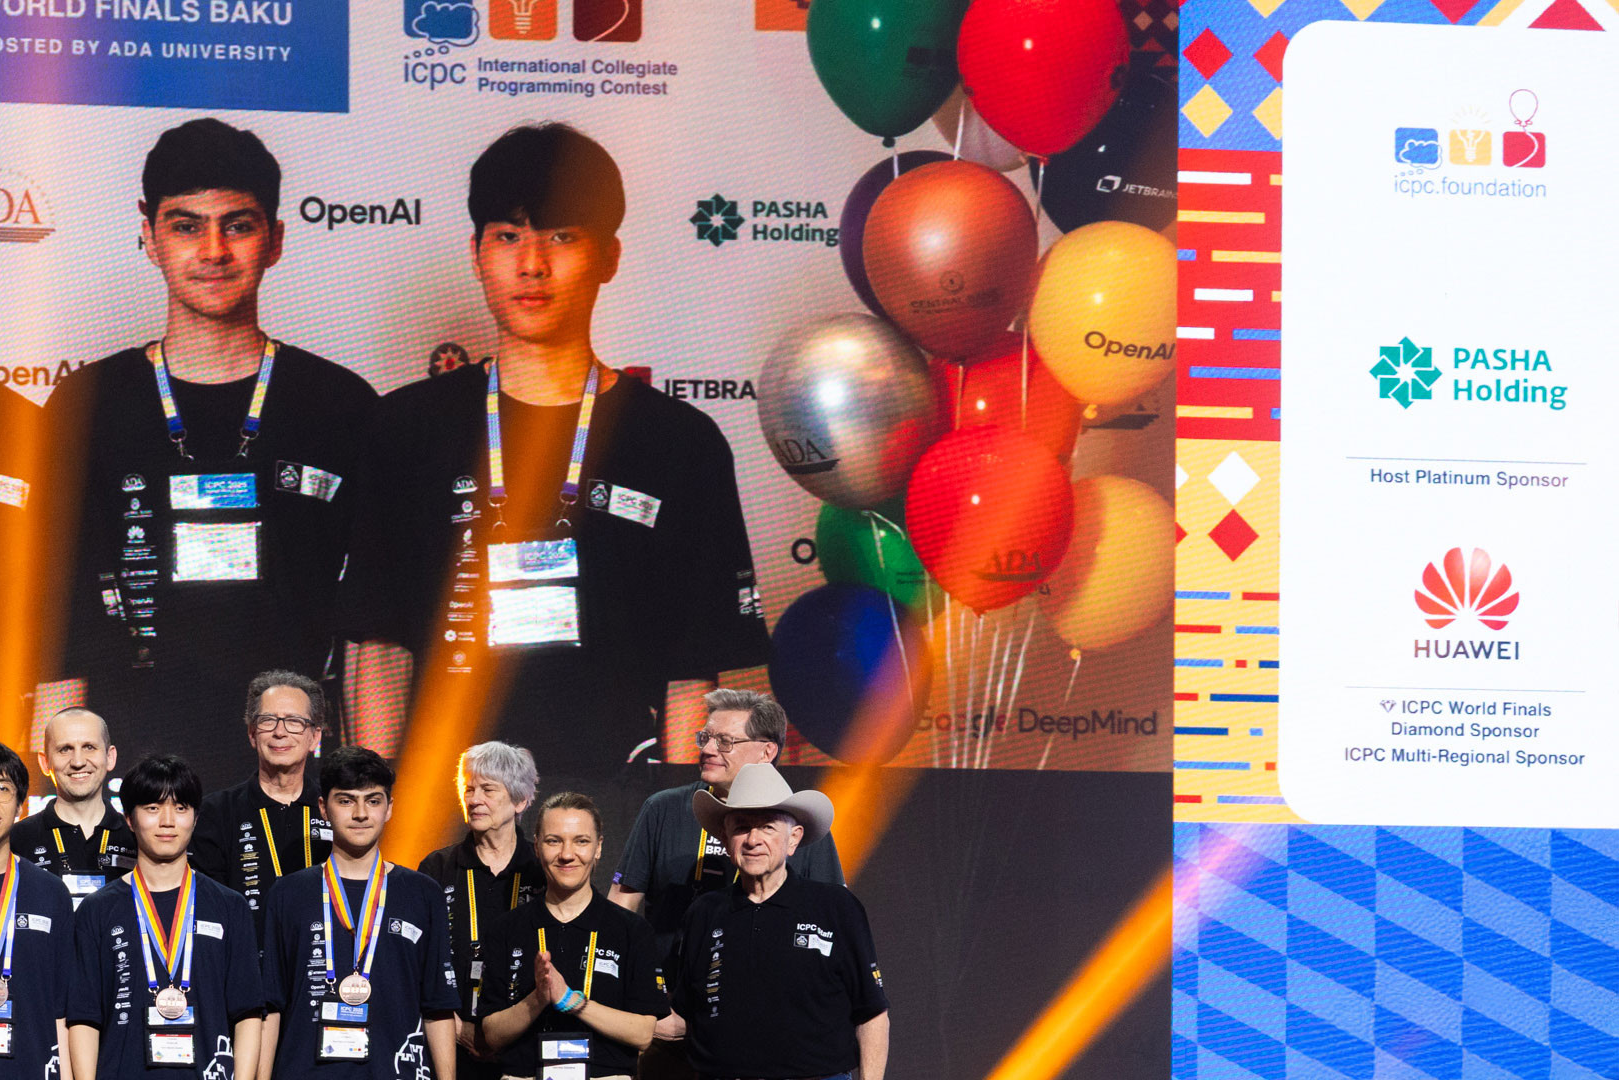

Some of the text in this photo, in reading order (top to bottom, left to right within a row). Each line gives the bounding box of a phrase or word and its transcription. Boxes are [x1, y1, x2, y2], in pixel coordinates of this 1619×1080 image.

[96, 0, 200, 22] FINALS
[210, 0, 292, 25] BAKU
[72, 40, 100, 55] BY
[108, 41, 153, 57] ADA
[161, 43, 291, 61] UNIVERSITY
[403, 56, 678, 90] icpc International Collegiate
[477, 77, 668, 97] Programming Contest
[1394, 175, 1547, 198] icpc.foundation
[299, 196, 422, 231] OpenAI
[752, 201, 828, 219] PASHA
[752, 223, 839, 247] Holding
[1084, 331, 1174, 361] OpenAI
[1453, 347, 1553, 372] PASHA
[664, 378, 757, 401] JETBRA
[1453, 379, 1568, 410] Holding
[1370, 469, 1569, 489] Host Platinum Sponsor
[1413, 640, 1520, 660] HUAWEI
[1402, 701, 1552, 717] ICPC World Finals
[1018, 707, 1159, 738] DeepMind
[1391, 722, 1540, 740] Diamond Sponsor
[1344, 747, 1585, 769] ICPC Multi-Regional Sponsor
[310, 818, 325, 826] CPC
[705, 845, 731, 857] BRA
[707, 836, 721, 845] JE
[796, 923, 817, 931] ICPC
[585, 946, 604, 956] IPC
